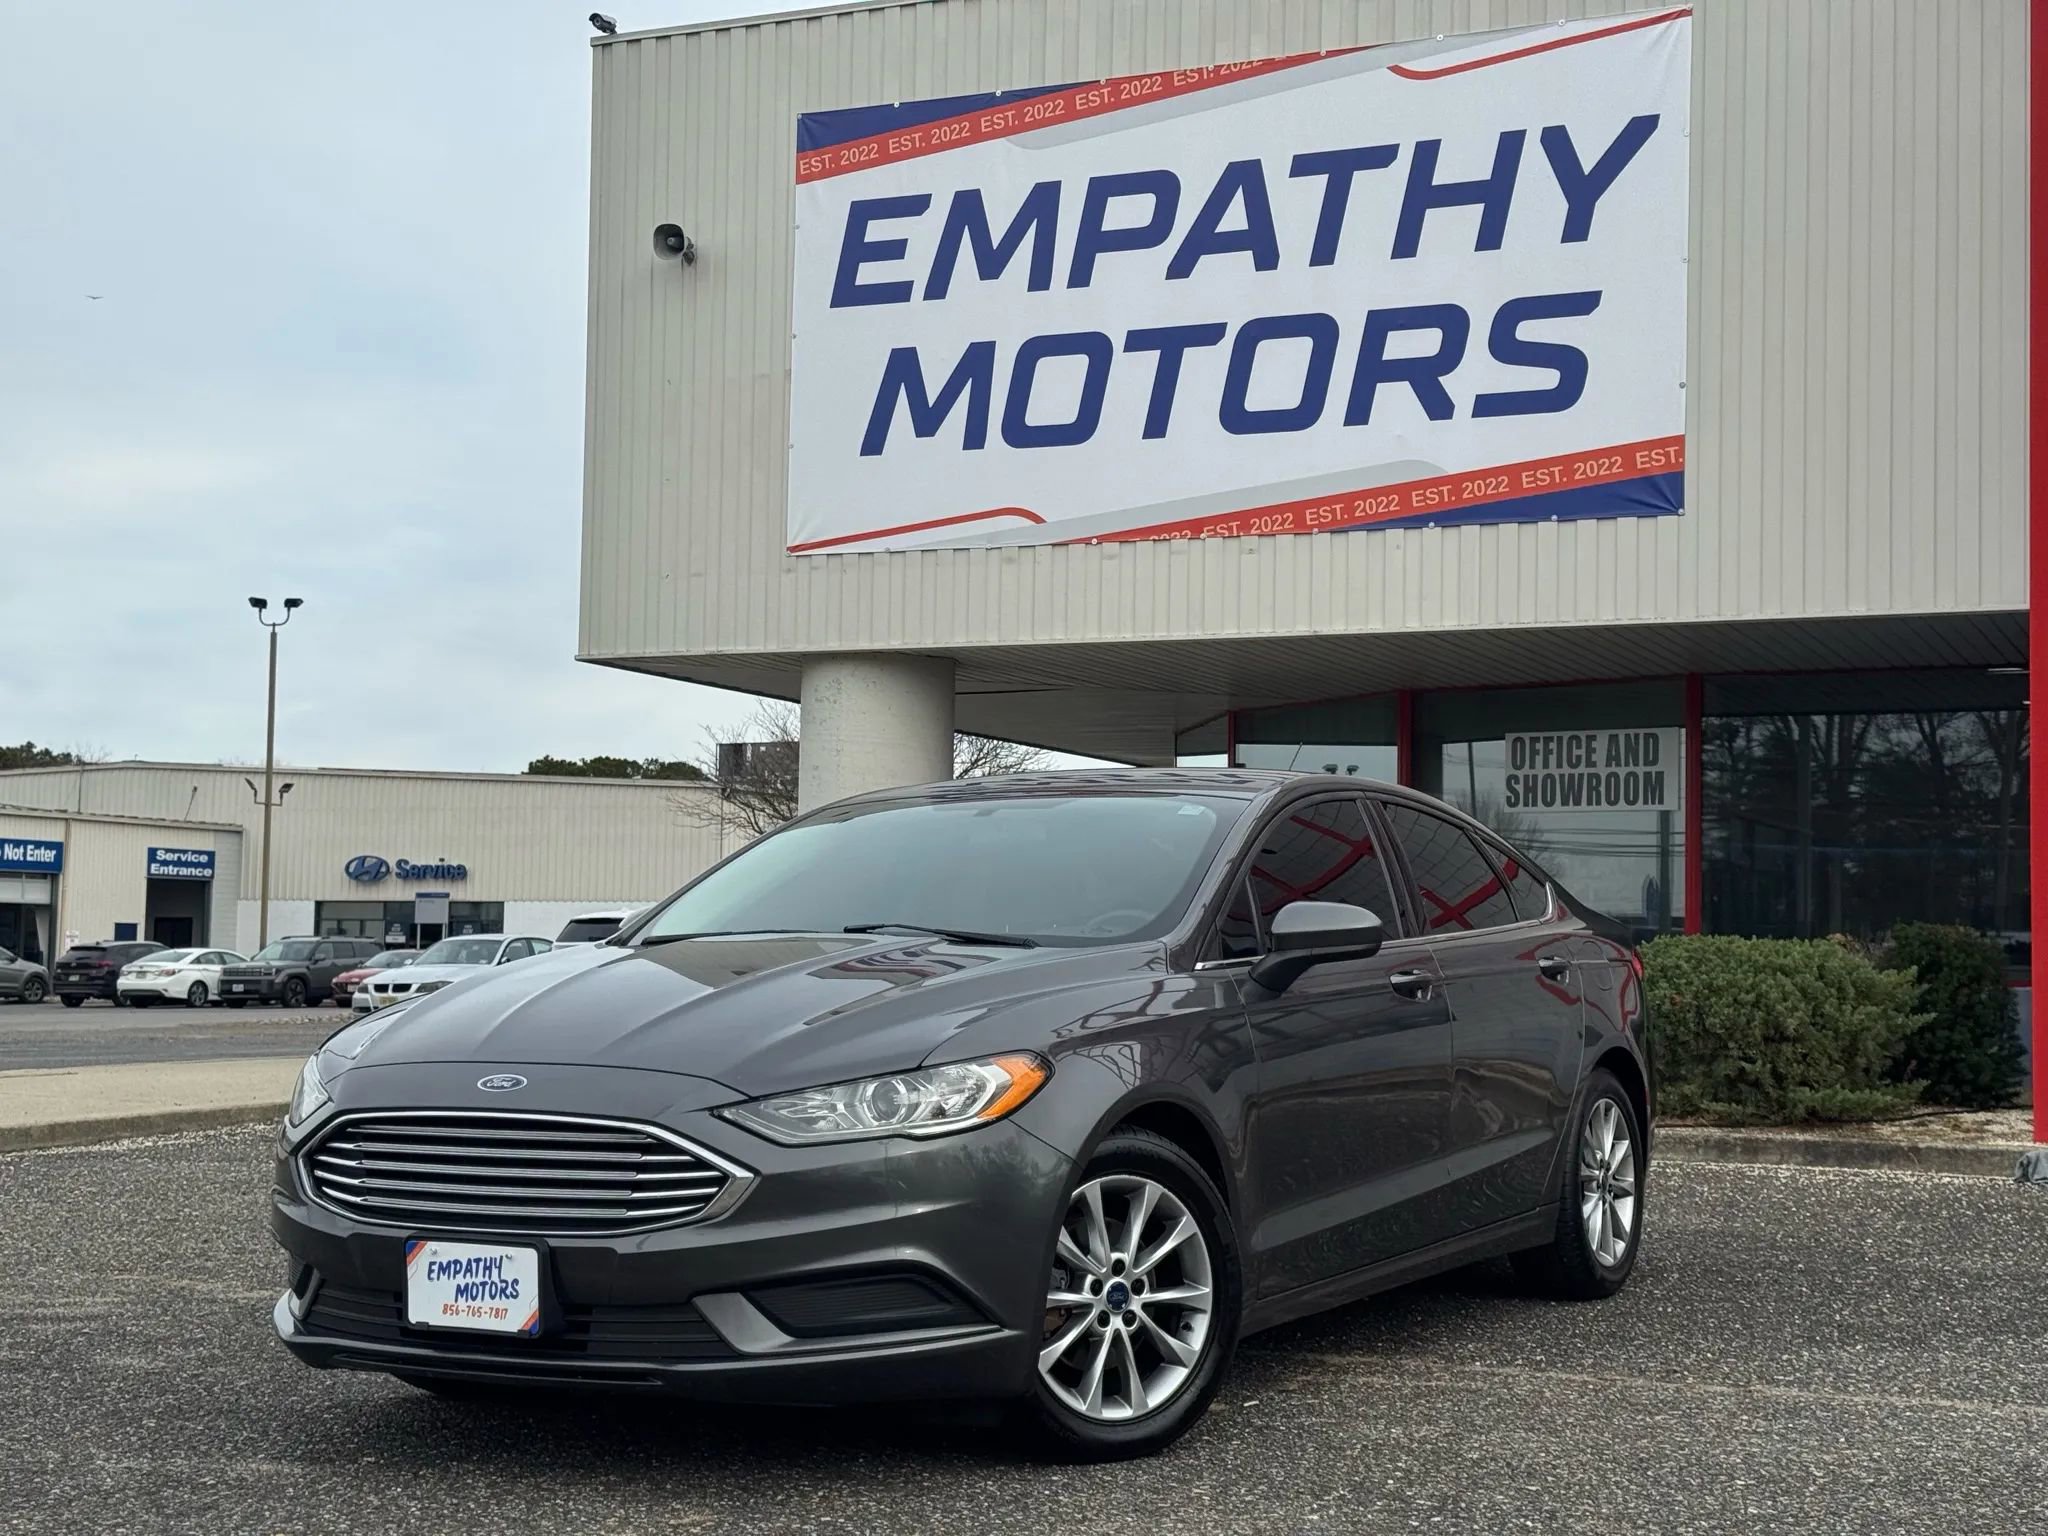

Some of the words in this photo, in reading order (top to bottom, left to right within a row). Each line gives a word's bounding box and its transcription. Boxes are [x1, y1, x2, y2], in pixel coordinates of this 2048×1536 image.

[800, 154, 835, 175] EST.
[840, 143, 879, 166] 2022
[888, 132, 926, 154] EST.
[931, 121, 971, 145] 2022
[980, 110, 1018, 133] EST.
[1024, 99, 1065, 123] 2022
[1075, 87, 1115, 111] EST.
[1120, 75, 1163, 100] 2022
[829, 113, 1660, 309] EMPATHY
[859, 290, 1603, 457] MOTORS
[1250, 512, 1295, 535] 2022
[1305, 503, 1348, 526] EST.
[1354, 494, 1400, 518] 2022
[1411, 485, 1456, 508] EST.
[1461, 476, 1510, 500] 2022
[1521, 466, 1567, 489] EST.
[1573, 455, 1624, 480] 2022
[1635, 446, 1684, 470] EST.
[1510, 734, 1598, 771] OFFICE
[1605, 732, 1660, 768] AND
[1505, 771, 1665, 809] SHOWROOM
[3, 843, 24, 861] Not
[26, 844, 57, 863] Enter
[156, 850, 209, 863] Service
[150, 863, 213, 878] Entrance
[395, 857, 468, 881] Service
[427, 1255, 504, 1282] EMPATHY
[454, 1278, 520, 1304] MOTORS
[442, 1303, 509, 1321] 856-765-7817
